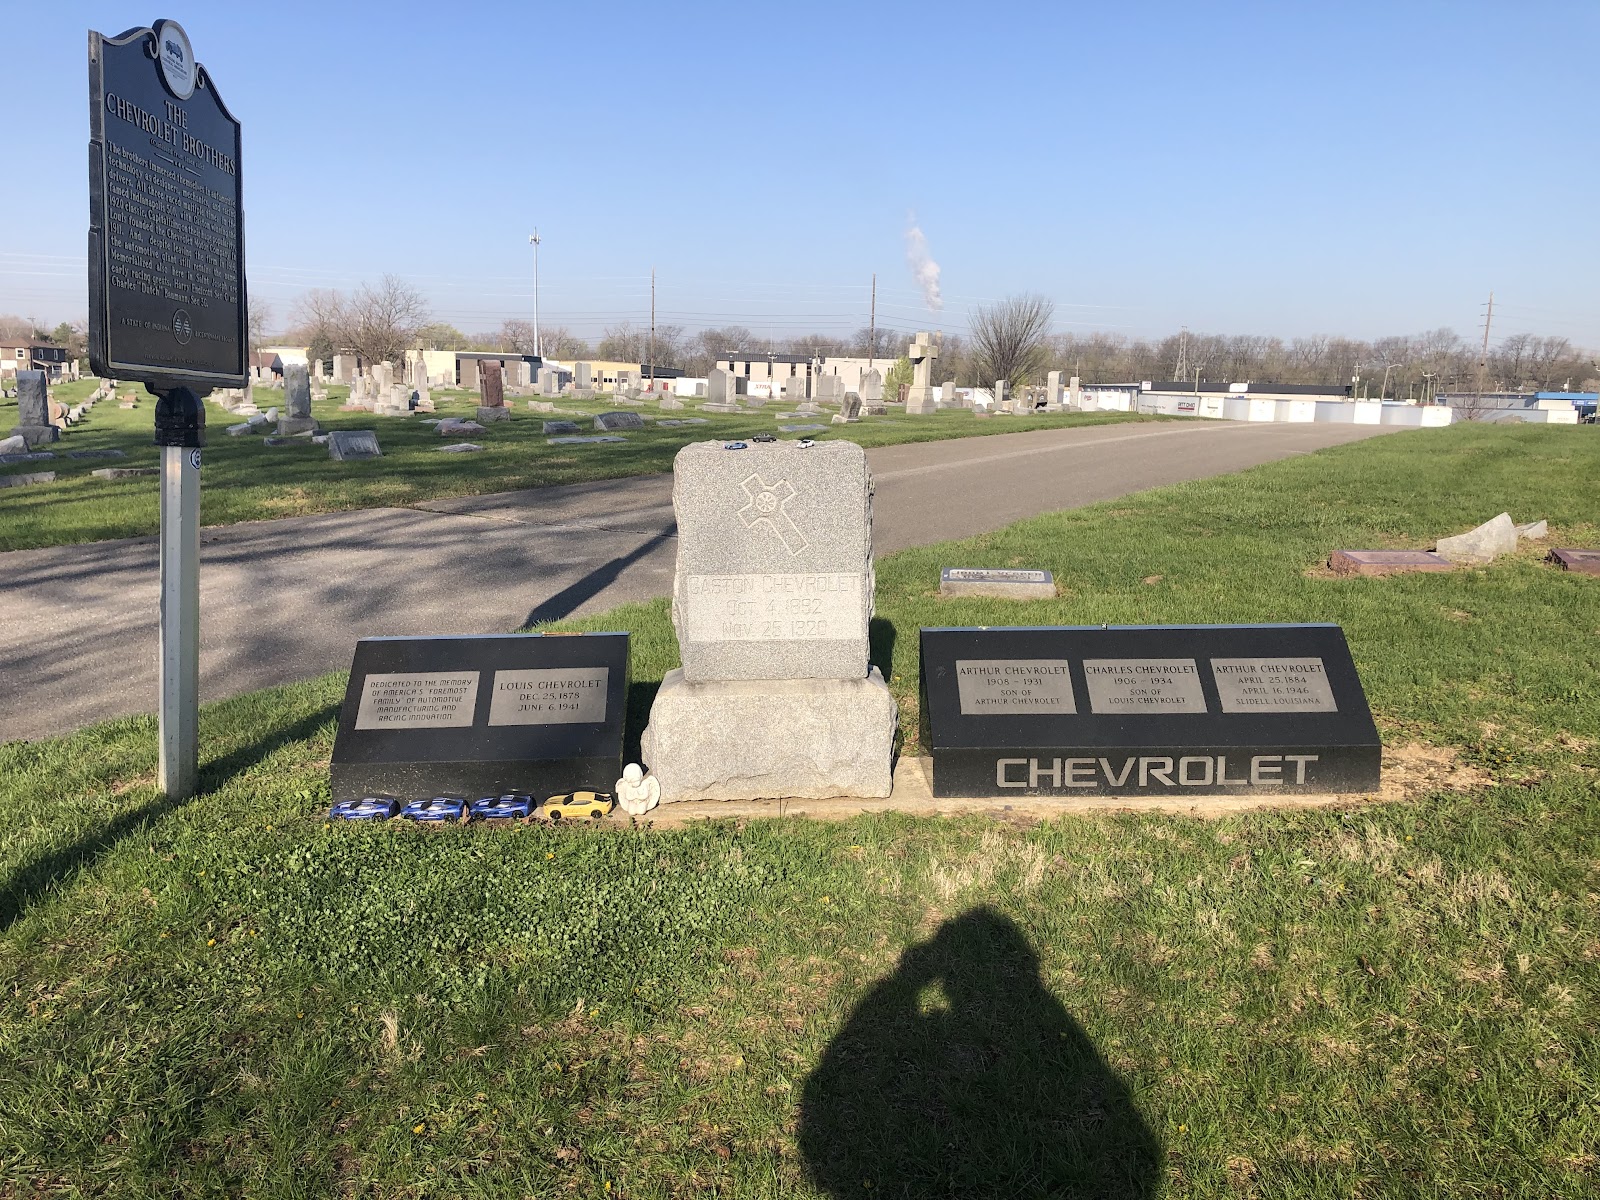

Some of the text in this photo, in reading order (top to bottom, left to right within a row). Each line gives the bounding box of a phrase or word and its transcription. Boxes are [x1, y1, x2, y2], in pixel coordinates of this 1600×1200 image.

[165, 100, 187, 130] THE
[107, 92, 235, 176] CHEVROLET BROTHERS
[108, 141, 121, 154] The
[122, 147, 148, 166] brothers
[149, 160, 175, 178] immersed
[108, 154, 143, 178] technology
[109, 168, 133, 186] drivers.
[136, 180, 146, 191] All
[148, 185, 164, 198] three
[166, 194, 181, 205] raced
[183, 201, 204, 214] multiple
[109, 183, 129, 198] famed
[130, 191, 165, 211] Indianapolis
[110, 196, 124, 209] 1920
[125, 203, 147, 217] classic.
[148, 210, 182, 230] Capitalizing
[110, 209, 126, 222] Louis
[129, 216, 153, 231] founded
[156, 225, 165, 236] the
[167, 229, 192, 244] Chevrolet
[110, 236, 121, 247] the
[124, 241, 159, 257] automotive
[162, 252, 176, 262] giant
[179, 258, 190, 266] still
[129, 228, 143, 241] And,
[150, 235, 170, 248] despite
[195, 250, 203, 260] the
[111, 249, 152, 268] Memorialized
[156, 263, 168, 272] also
[172, 267, 184, 276] here
[111, 265, 128, 277] early
[132, 270, 150, 282] racing
[112, 276, 136, 291] Charles
[127, 318, 141, 327] STATE
[689, 576, 858, 594] GASTON CHEVROLET
[1136, 666, 1195, 674] CHEVROLET
[500, 680, 601, 690] LOUIS CHEVROLET
[996, 754, 1319, 788] CHEVROLET
